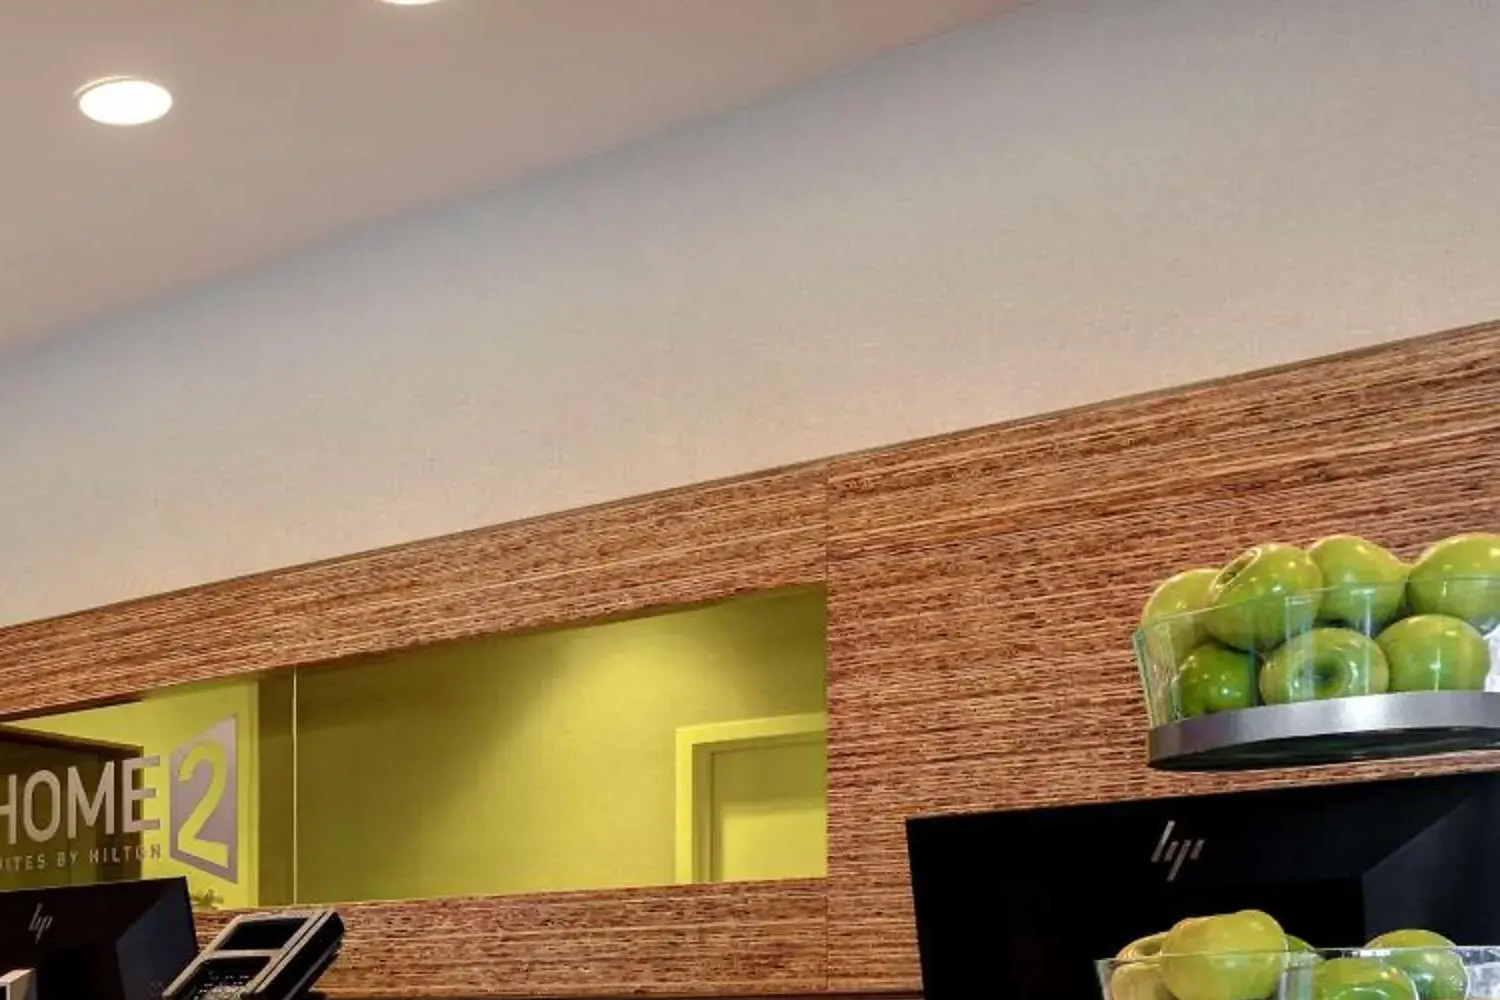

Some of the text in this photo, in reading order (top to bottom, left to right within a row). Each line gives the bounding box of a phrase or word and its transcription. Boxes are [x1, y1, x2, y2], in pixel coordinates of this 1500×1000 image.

[177, 743, 229, 870] 2
[56, 850, 79, 868] BY
[89, 843, 161, 864] HILTON
[1150, 819, 1205, 882] hp
[28, 902, 54, 945] hp
